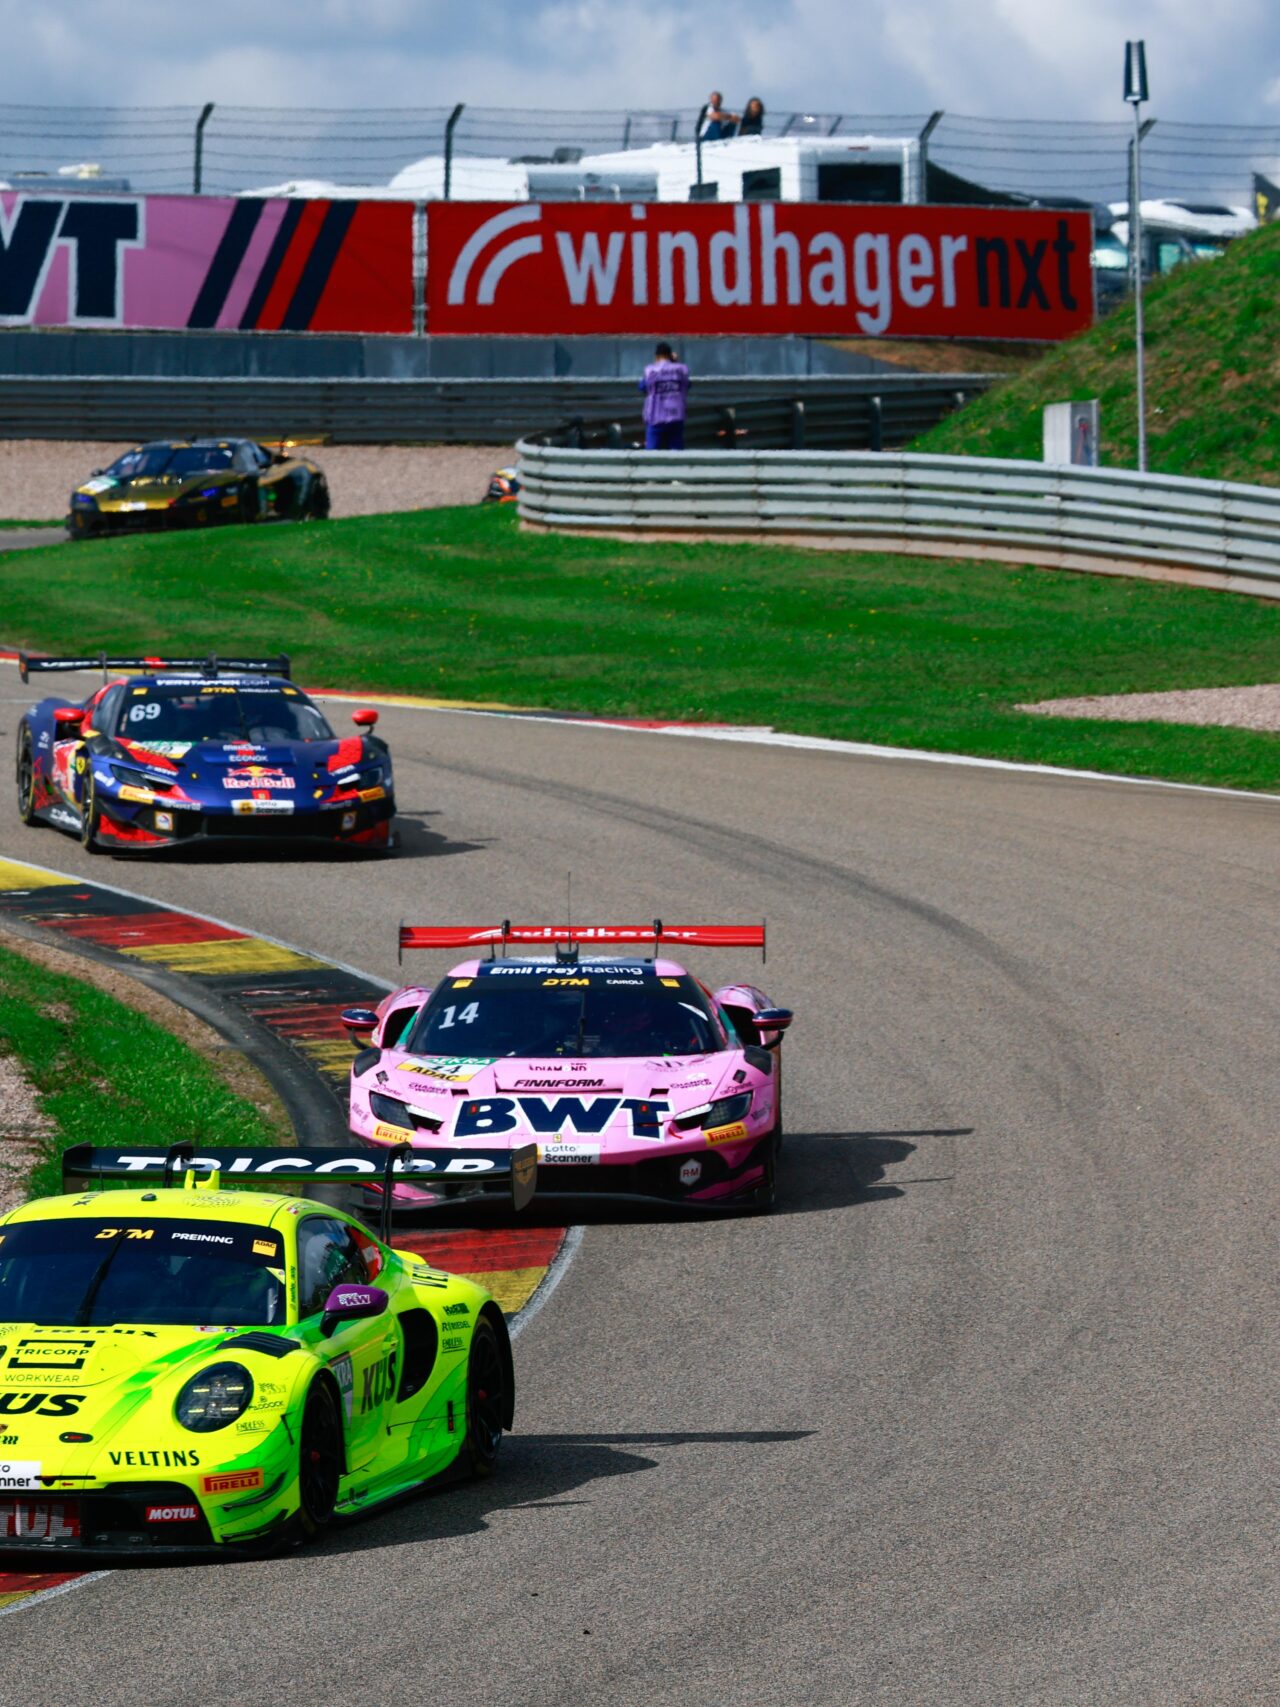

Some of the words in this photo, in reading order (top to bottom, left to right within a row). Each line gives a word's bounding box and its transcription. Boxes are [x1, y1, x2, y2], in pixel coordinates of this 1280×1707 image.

[129, 702, 161, 722] 69
[222, 777, 260, 789] Red
[261, 777, 296, 789] Bull
[490, 966, 532, 975] Emil
[535, 966, 579, 976] Frey
[582, 966, 644, 976] Racing
[542, 979, 590, 987] DTM
[438, 1001, 480, 1030] 14
[410, 1066, 460, 1081] ADAC
[514, 1079, 605, 1088] FINNFORM
[453, 1096, 670, 1140] BWT
[706, 1124, 745, 1142] PIRELLI
[544, 1153, 593, 1164] Scanner
[171, 1232, 234, 1245] PREINING
[14, 1348, 90, 1356] TRICORP
[4, 1374, 80, 1383] WORKWEAR
[109, 1449, 200, 1467] VELTINS
[204, 1470, 260, 1493] PIRELLI
[148, 1507, 197, 1521] MOTUL
